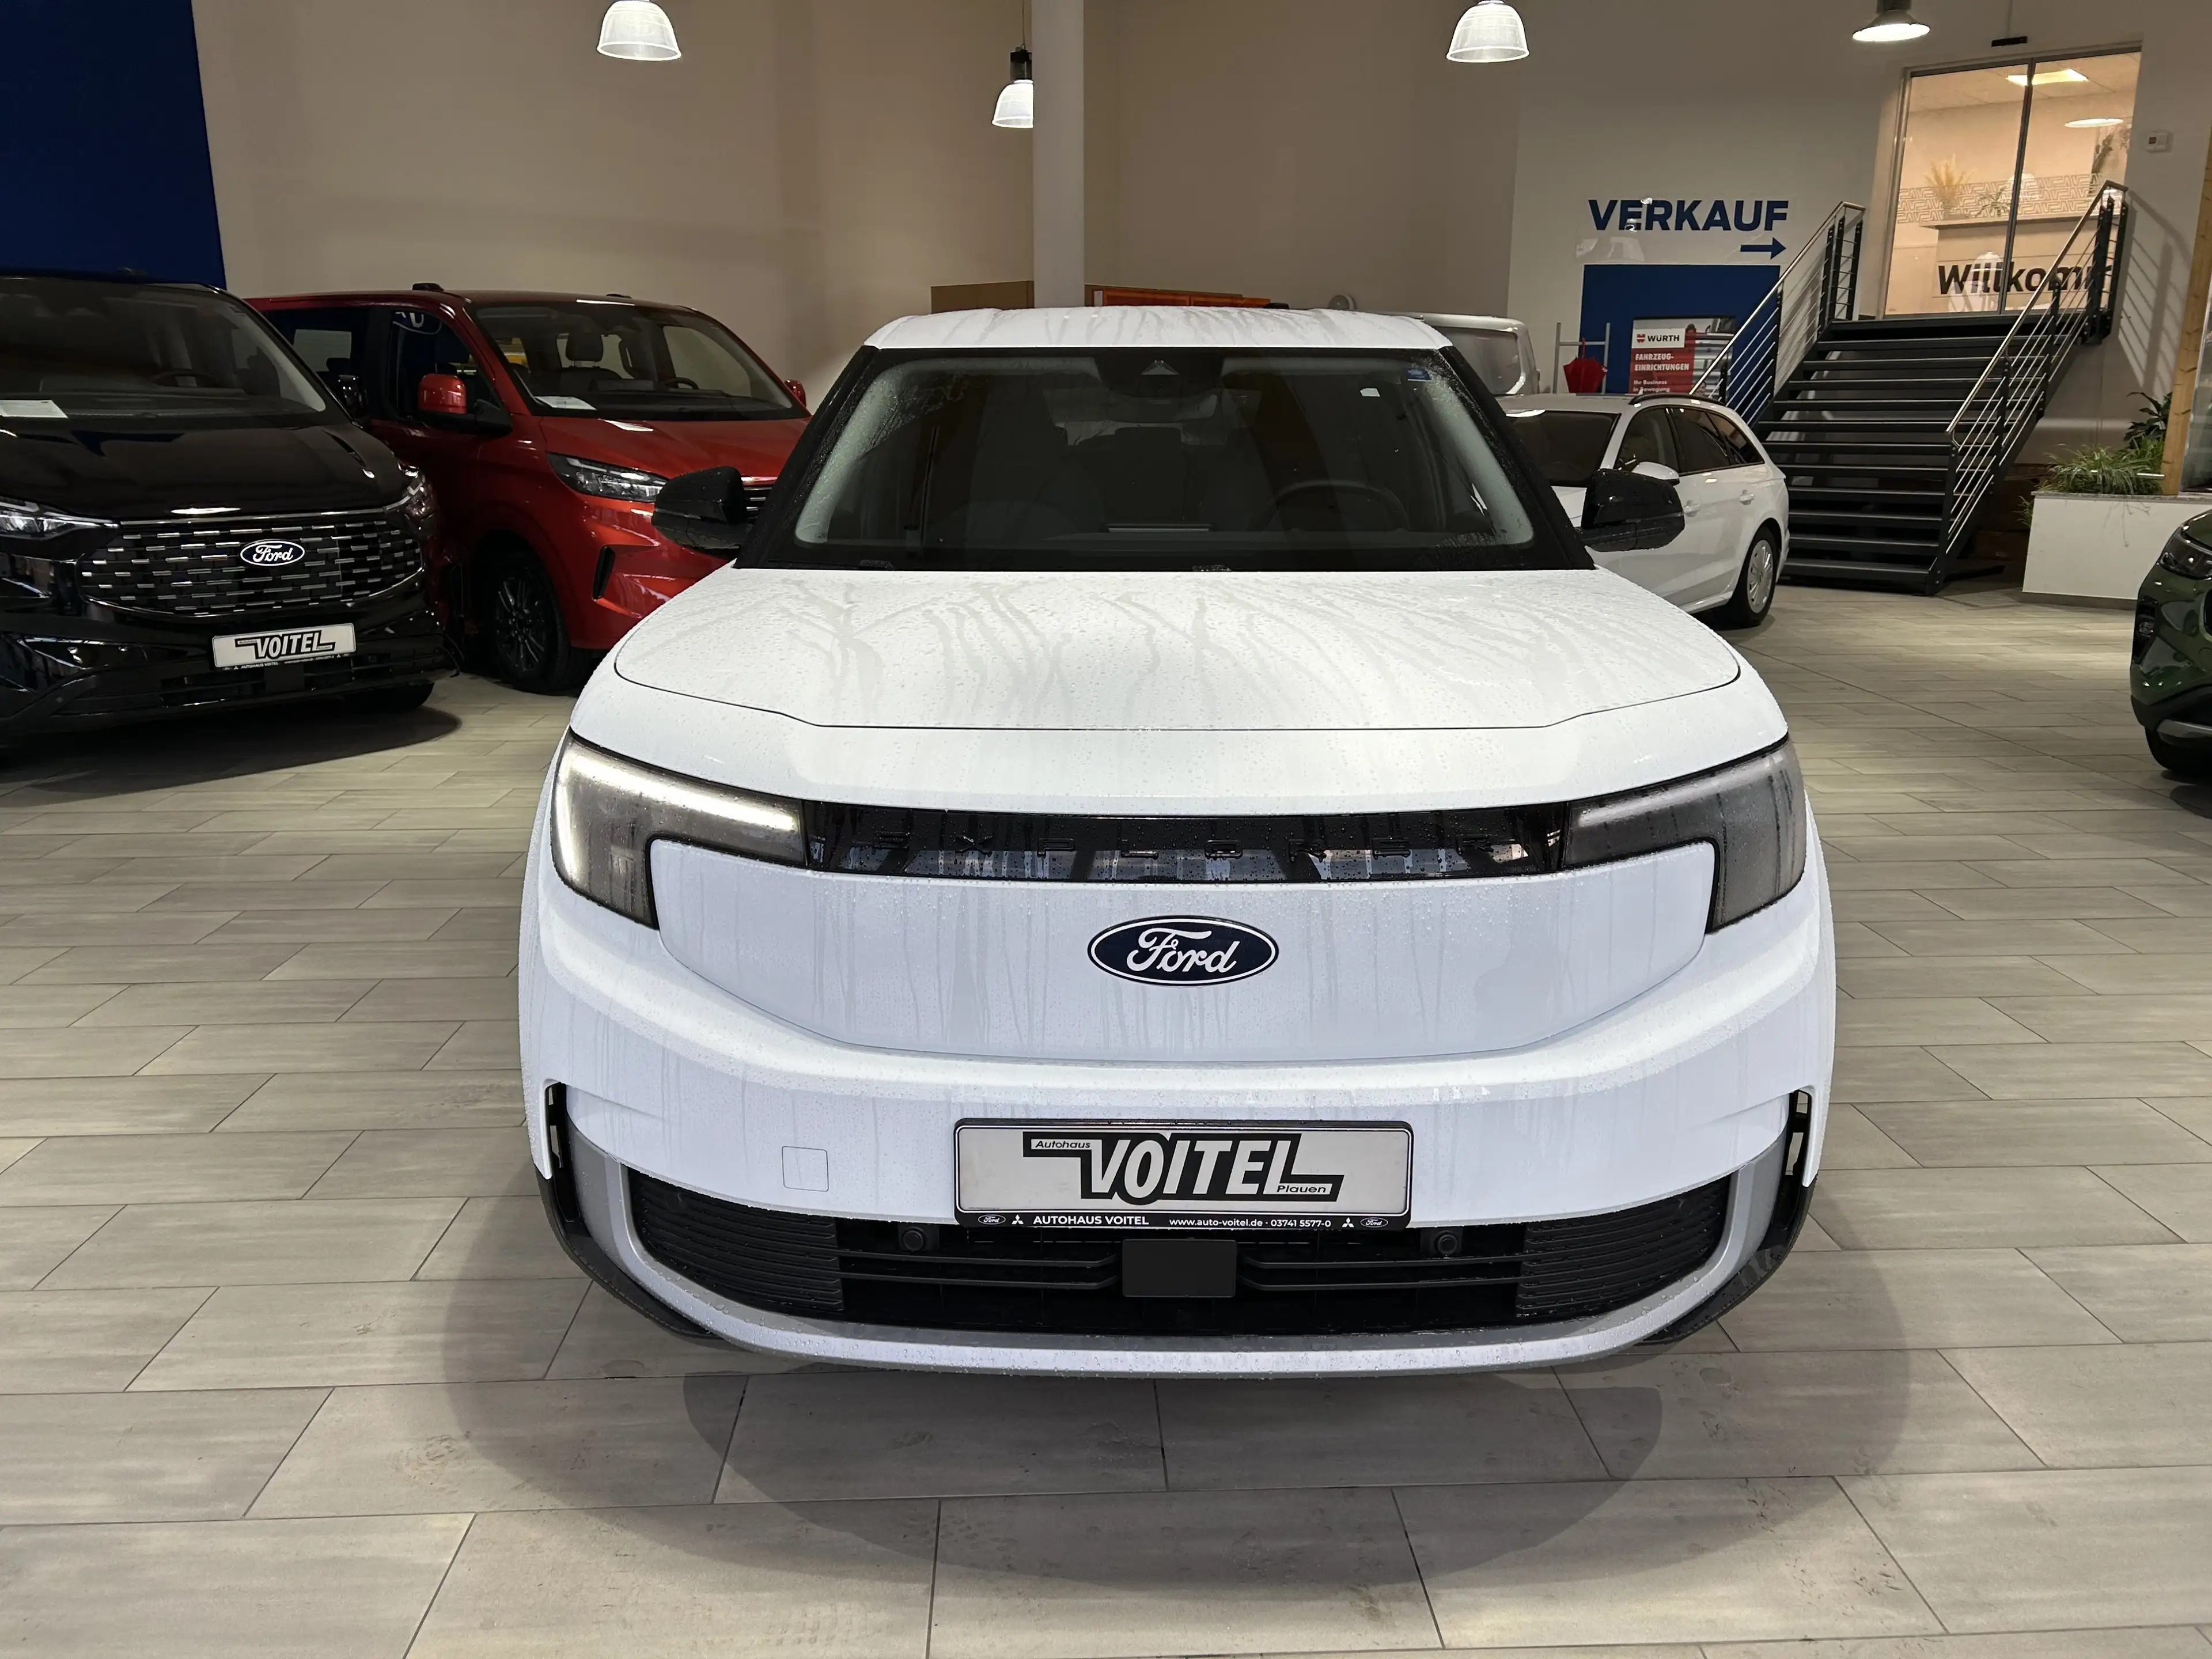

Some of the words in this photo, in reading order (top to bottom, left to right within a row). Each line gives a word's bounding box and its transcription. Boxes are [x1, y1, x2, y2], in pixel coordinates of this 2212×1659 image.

[1588, 199, 1789, 230] VERKAUF
[1634, 363, 1690, 371] EINRICHTUNGEN
[252, 544, 294, 562] Ford
[256, 632, 320, 658] VOITEL
[1126, 927, 1240, 973] Ford
[1035, 1141, 1091, 1149] Autohaus
[1090, 1139, 1293, 1199] VOITEL
[1277, 1185, 1327, 1193] Plauen
[1033, 1215, 1103, 1225] AUTOHAUS
[1104, 1216, 1149, 1225] VOITEL
[1169, 1218, 1263, 1228] www.auto-voitel.de
[1270, 1219, 1297, 1228] 03741
[1299, 1219, 1331, 1228] 5577-0
